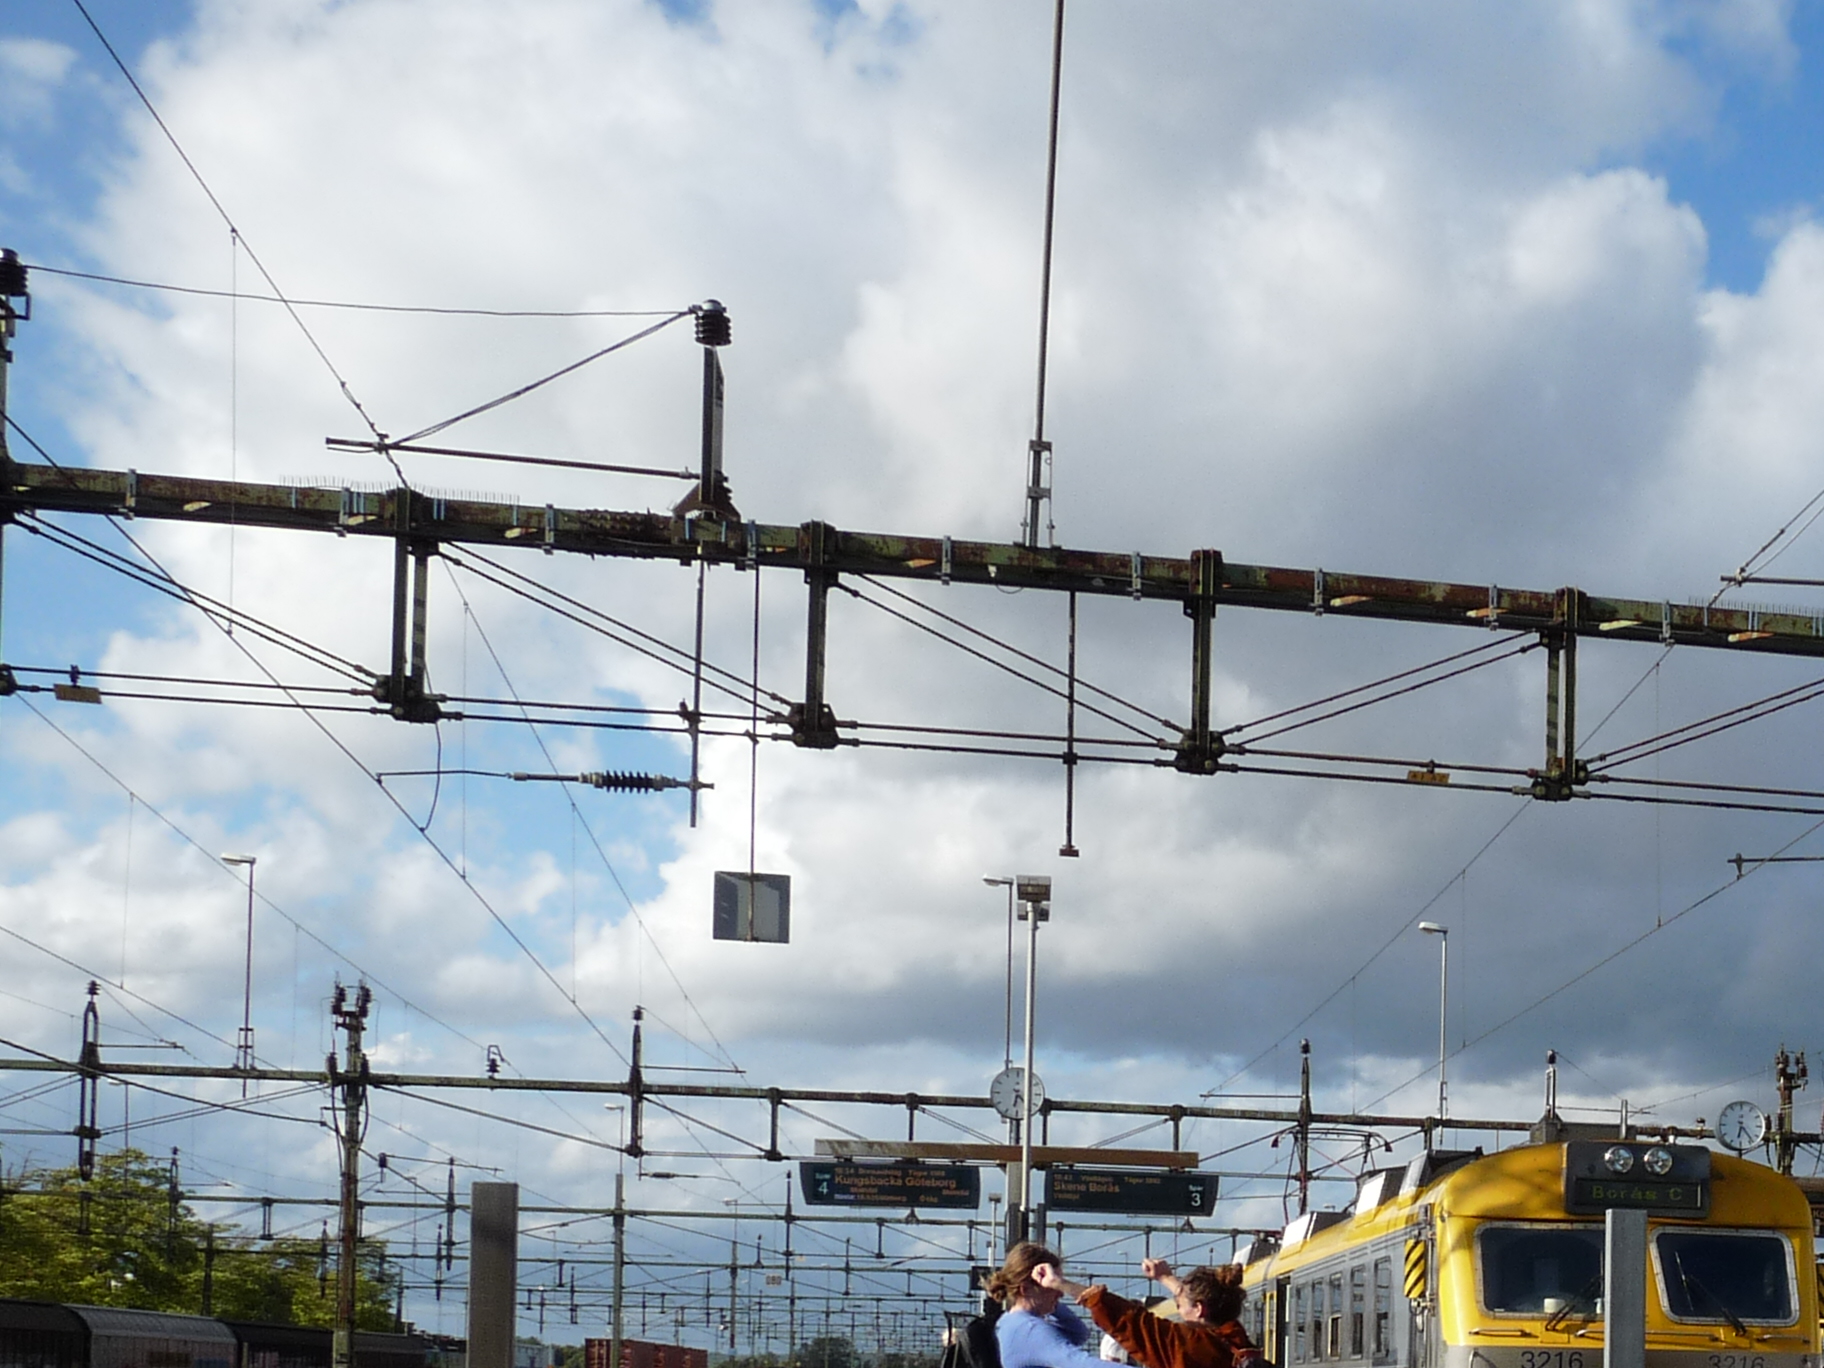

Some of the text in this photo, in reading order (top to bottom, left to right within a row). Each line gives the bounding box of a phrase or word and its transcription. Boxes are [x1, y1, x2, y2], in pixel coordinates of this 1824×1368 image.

[835, 1175, 956, 1188] Kungsbacka Göteborg
[1053, 1181, 1120, 1193] Skene Borås
[818, 1182, 829, 1195] 4
[1592, 1186, 1682, 1200] Borås C
[1191, 1193, 1201, 1207] 3
